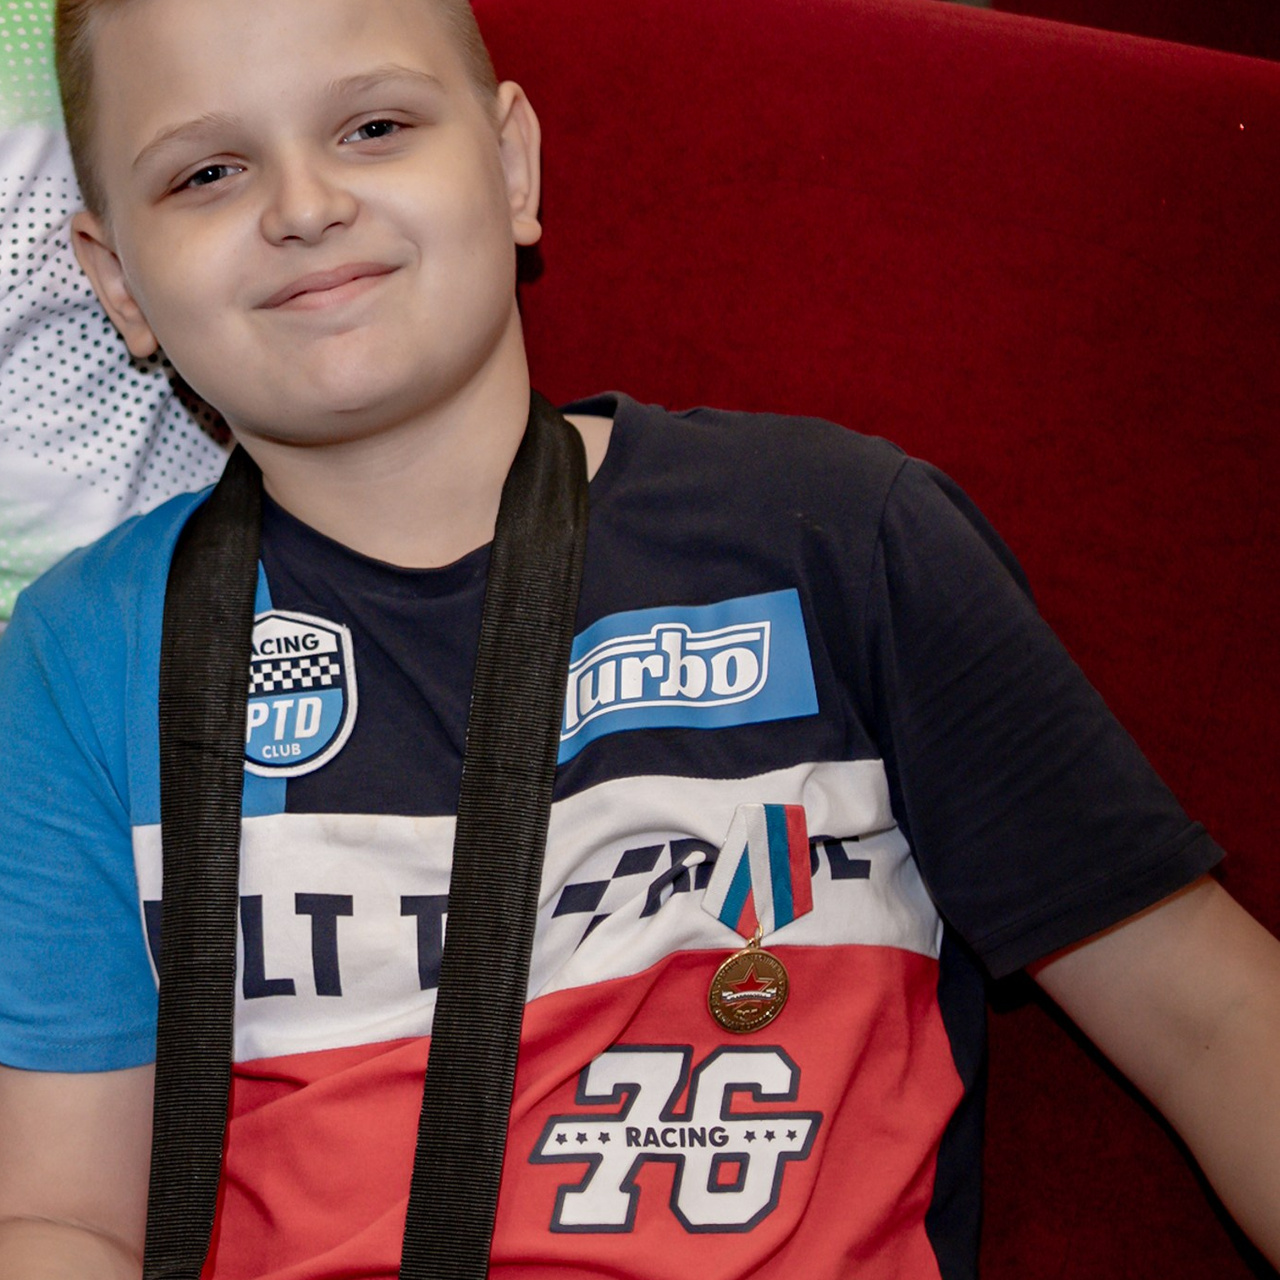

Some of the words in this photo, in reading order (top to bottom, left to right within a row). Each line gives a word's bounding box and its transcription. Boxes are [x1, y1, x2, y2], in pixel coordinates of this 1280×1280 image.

[247, 696, 322, 743] PTD
[262, 742, 302, 759] CLUB
[625, 1126, 730, 1148] RACING
